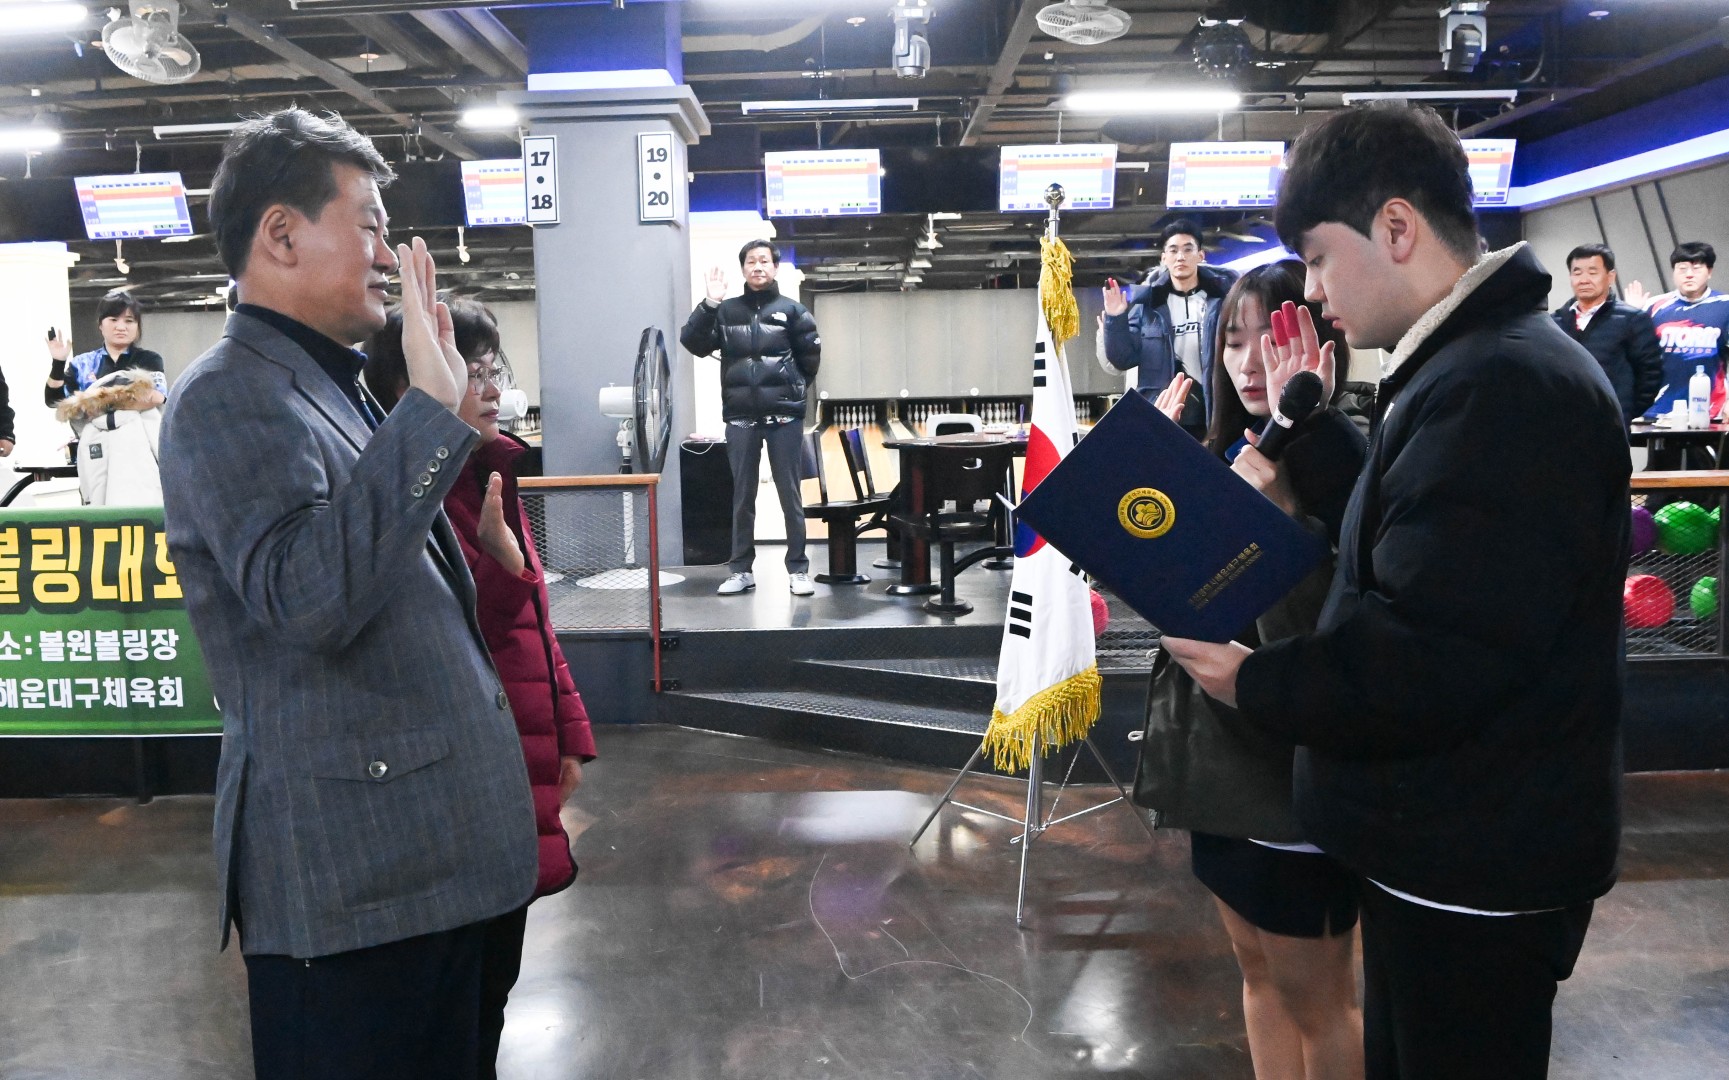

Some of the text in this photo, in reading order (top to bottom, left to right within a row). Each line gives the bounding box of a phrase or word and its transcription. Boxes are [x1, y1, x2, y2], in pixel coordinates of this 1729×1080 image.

[530, 151, 550, 166] 17
[646, 148, 668, 162] 19
[531, 194, 553, 210] 18
[647, 191, 669, 206] 20
[38, 628, 180, 662] 볼원볼링장
[0, 676, 184, 709] 해운대구체육회
